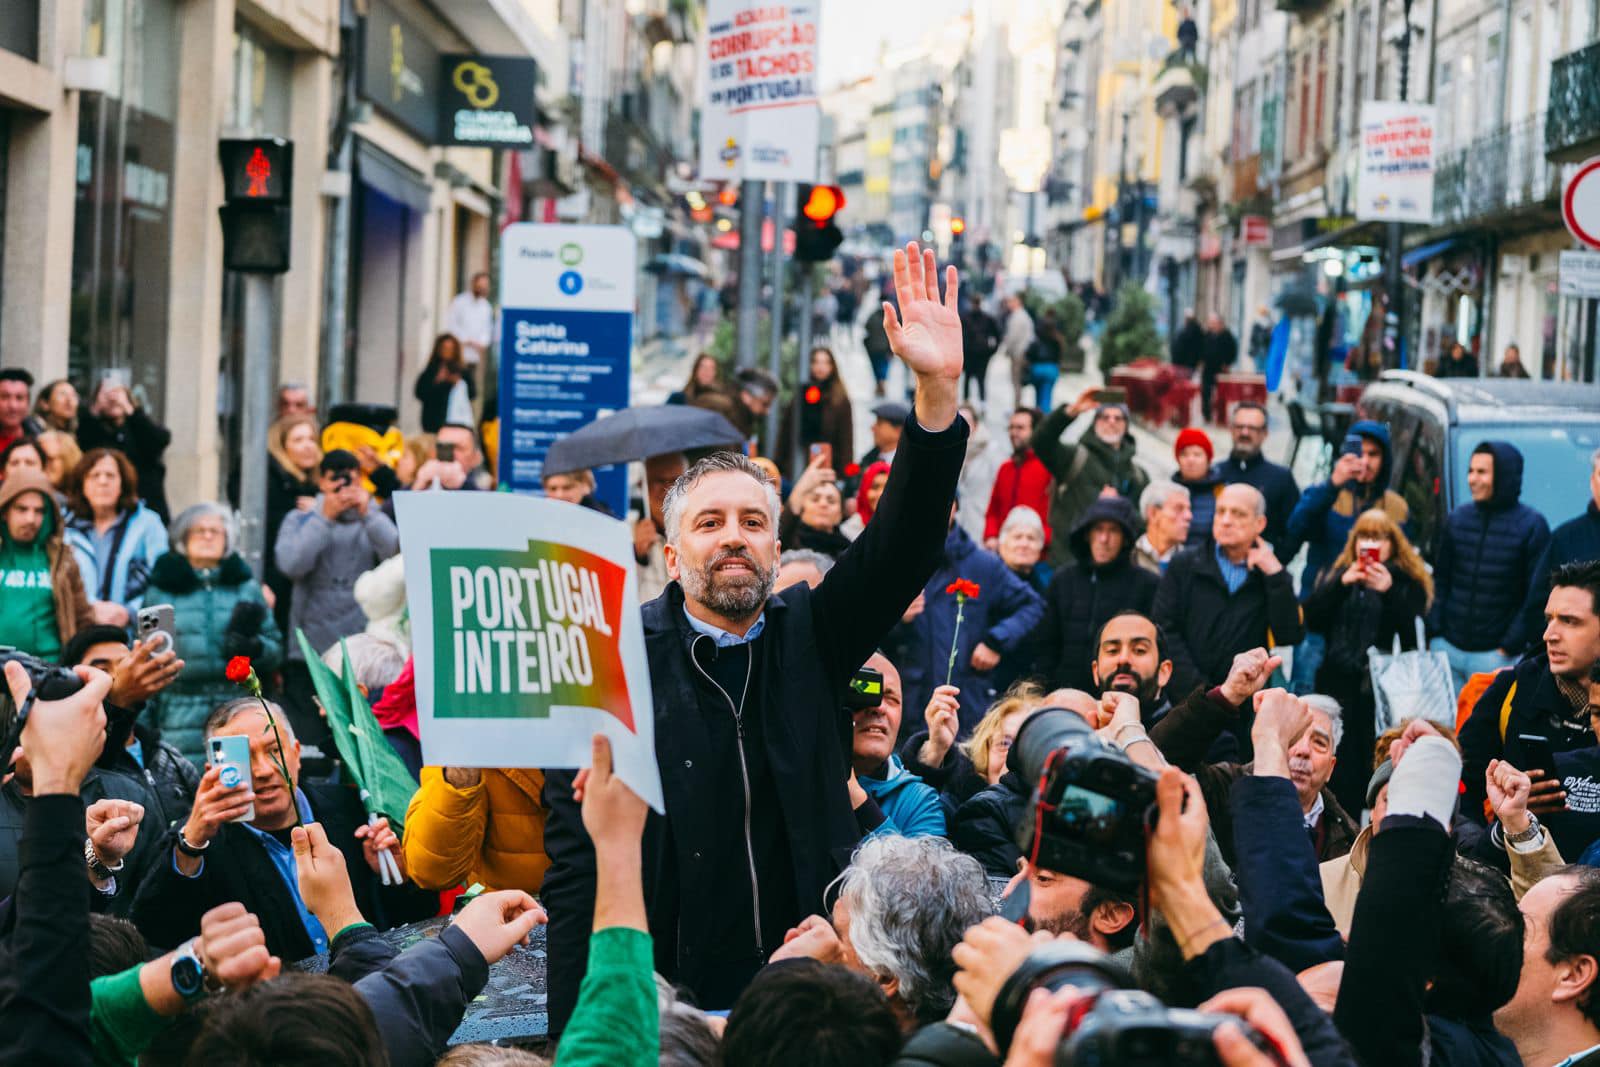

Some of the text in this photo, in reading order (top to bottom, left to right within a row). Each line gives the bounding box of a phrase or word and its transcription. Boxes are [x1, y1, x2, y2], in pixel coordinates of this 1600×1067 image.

[736, 51, 815, 81] TACHOS
[726, 79, 817, 106] PORTUGAL
[515, 320, 567, 339] Santa
[515, 338, 589, 357] Catarina
[450, 559, 612, 637] PORTUGAL
[454, 622, 593, 694] INTEIRO
